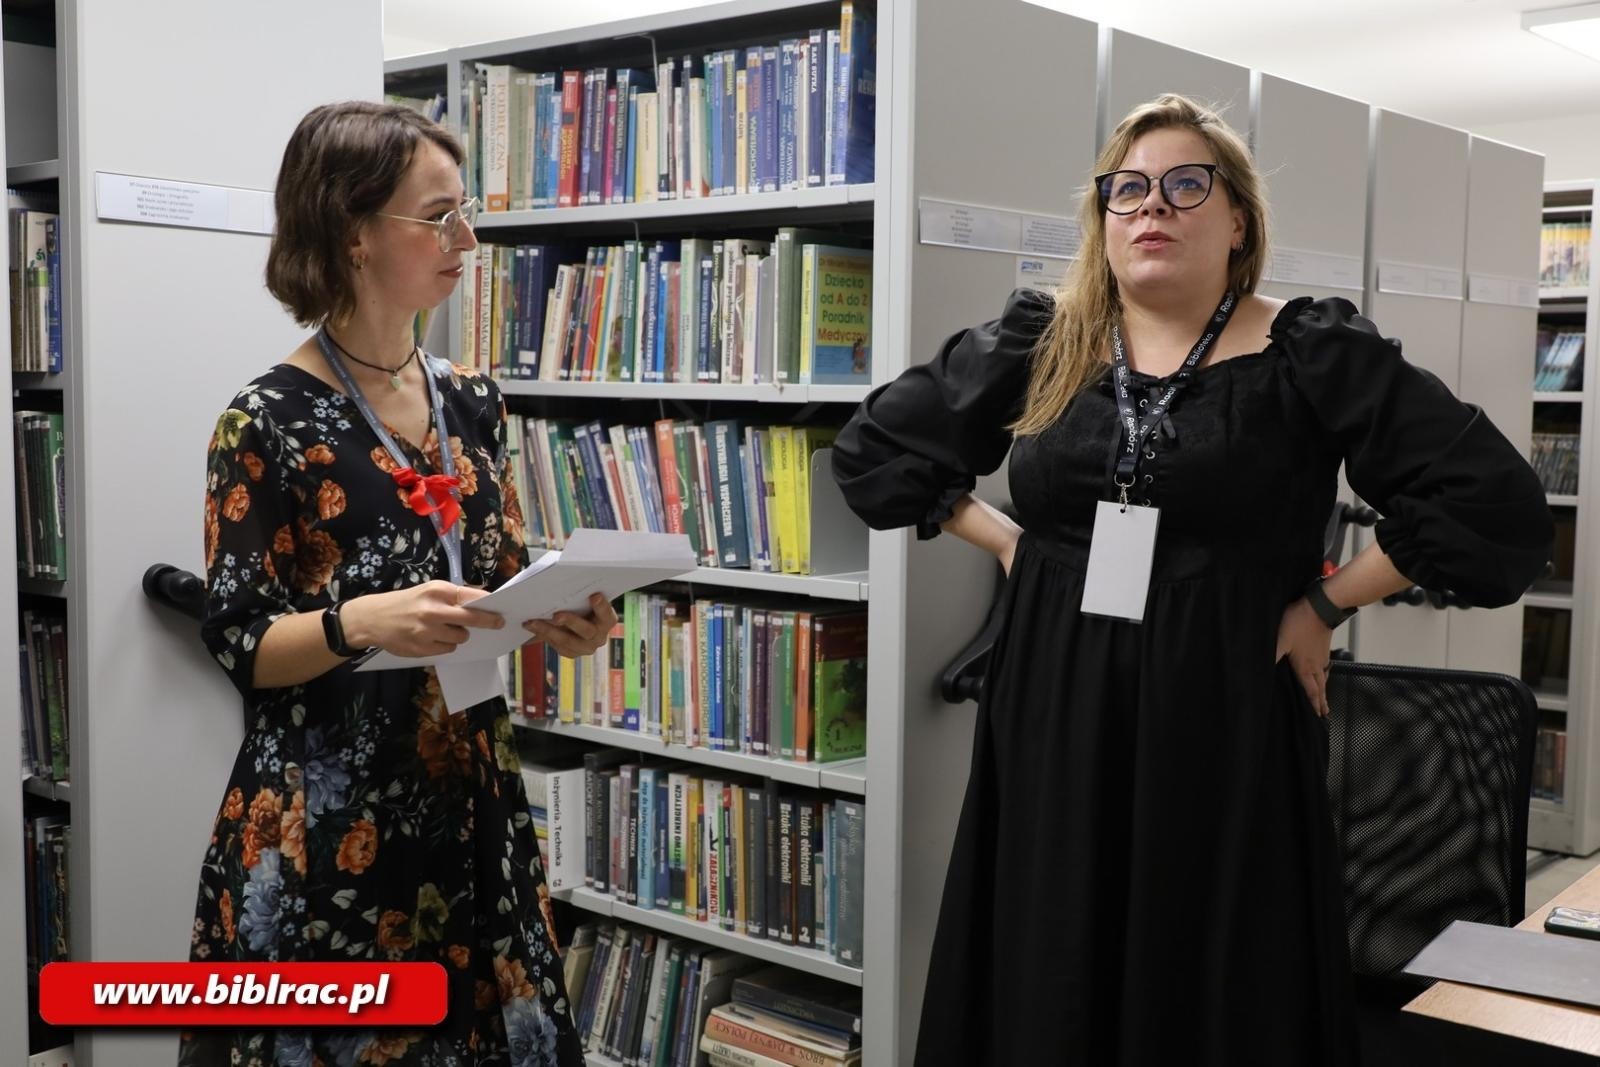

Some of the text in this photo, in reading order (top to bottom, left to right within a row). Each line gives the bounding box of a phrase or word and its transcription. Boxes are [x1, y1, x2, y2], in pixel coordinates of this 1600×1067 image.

[495, 84, 506, 171] PODRĘCZNA
[820, 293, 868, 306] od A do Z
[825, 274, 864, 288] Dziecko
[725, 286, 734, 330] psychologia
[822, 310, 864, 324] Poradnik
[481, 304, 489, 357] FARMACJI
[818, 328, 868, 343] Medyczny
[1187, 333, 1214, 367] Biblioteka
[1126, 416, 1139, 454] Racibórz
[719, 484, 733, 536] WSPÓŁCZESNA
[674, 782, 682, 834] ENERGETYCZN
[554, 826, 562, 867] Technika
[780, 804, 792, 883] ztuka elektroniki
[800, 807, 812, 886] ztuka elektroniki
[715, 1022, 747, 1039] POLSCE
